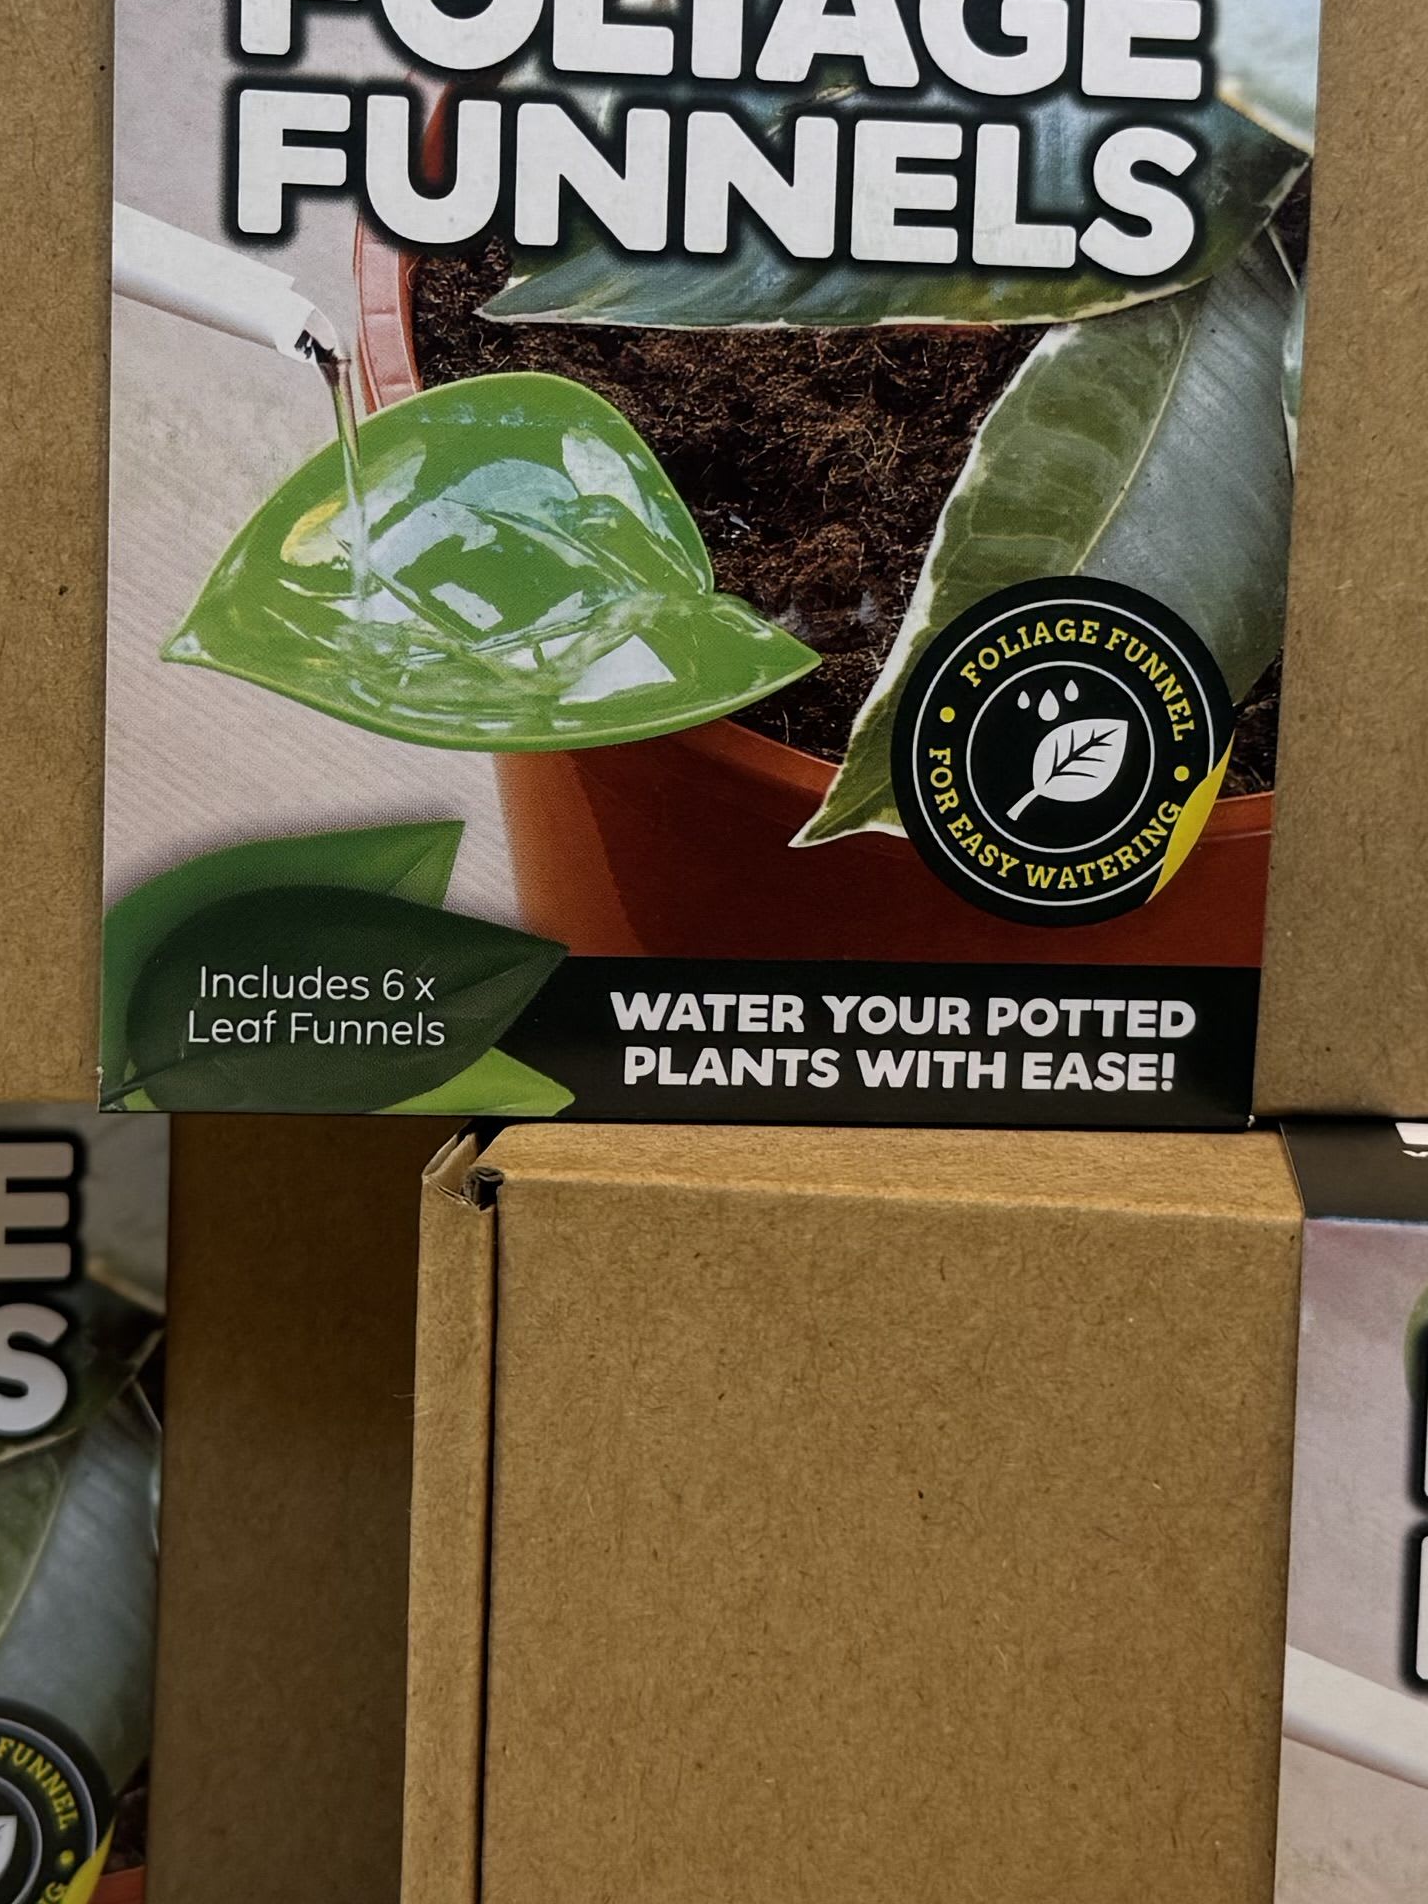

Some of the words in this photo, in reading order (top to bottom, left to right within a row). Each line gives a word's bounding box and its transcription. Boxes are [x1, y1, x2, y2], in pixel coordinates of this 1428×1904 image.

[236, 88, 1199, 277] FUNNELS
[959, 618, 1101, 688] FOLIAGE
[1104, 627, 1195, 742] FUNNEL
[928, 747, 960, 814] FOR
[946, 812, 1020, 879] EASY
[1024, 799, 1184, 890] WATERING
[199, 963, 371, 1001] Includes
[381, 967, 406, 1002] 6
[413, 975, 436, 1002] x
[187, 1008, 278, 1044] Leaf
[289, 1010, 446, 1047] Funnels
[609, 991, 805, 1034] WATER
[821, 994, 972, 1036] YOUR
[986, 996, 1197, 1039] POTTED
[623, 1045, 841, 1089] PLANTS
[855, 1048, 1007, 1090] WITH
[1021, 1050, 1177, 1092] EASE!
